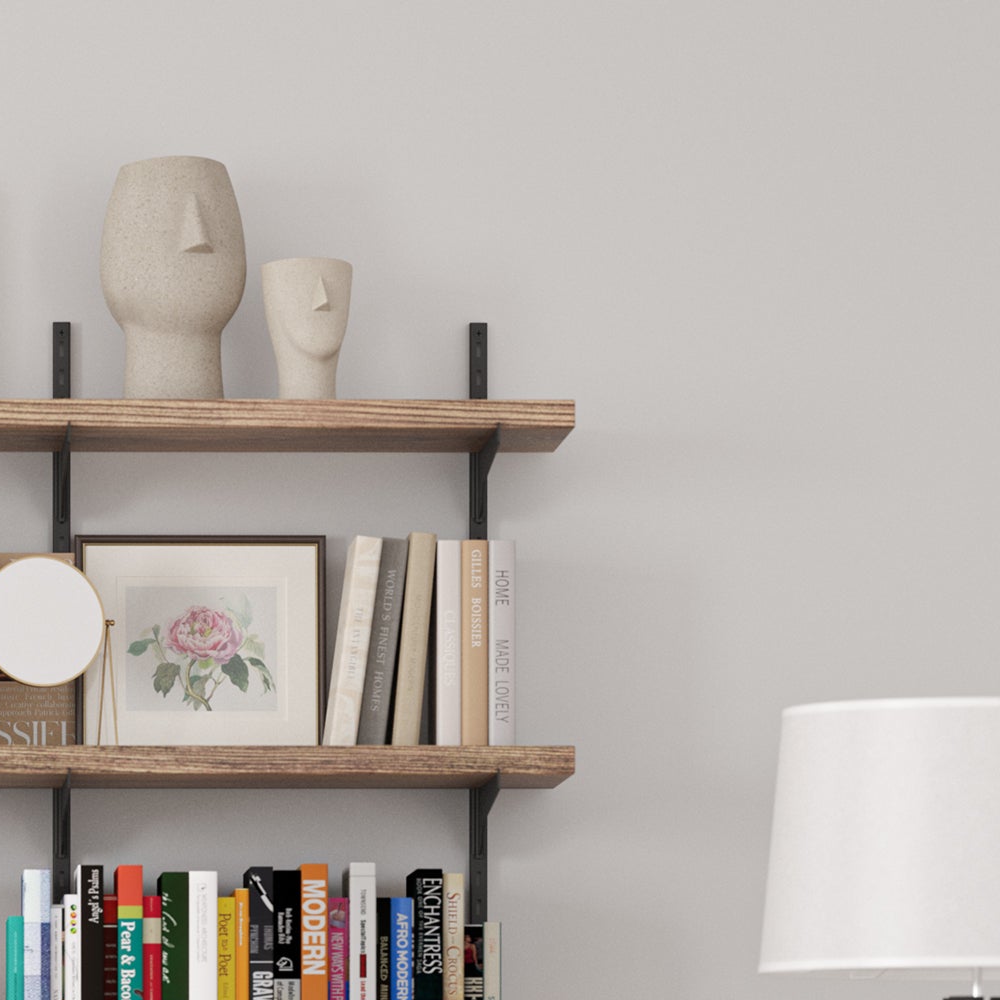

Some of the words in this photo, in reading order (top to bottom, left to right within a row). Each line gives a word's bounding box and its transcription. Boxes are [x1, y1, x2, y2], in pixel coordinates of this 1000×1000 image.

[471, 549, 482, 589] GILLES
[495, 570, 510, 606] HOME
[471, 597, 482, 648] BOISSIER
[374, 626, 390, 664] FINEST
[495, 639, 510, 673] MADE
[370, 670, 384, 712] HOMES
[495, 680, 510, 724] LOVELY
[88, 868, 99, 895] Psalms
[218, 913, 232, 937] Poet
[302, 879, 327, 975] MODERN
[397, 912, 409, 948] AFRO
[421, 878, 442, 975] ENCHANTRESS
[446, 891, 462, 935] SHIELD
[120, 920, 136, 952] Pear
[331, 932, 344, 951] NEW
[120, 953, 136, 967] &
[218, 953, 232, 977] Poet
[331, 951, 344, 972] WAYS
[379, 936, 390, 981] BALANCED
[446, 945, 462, 996] CROCUS
[331, 973, 344, 996] WITH
